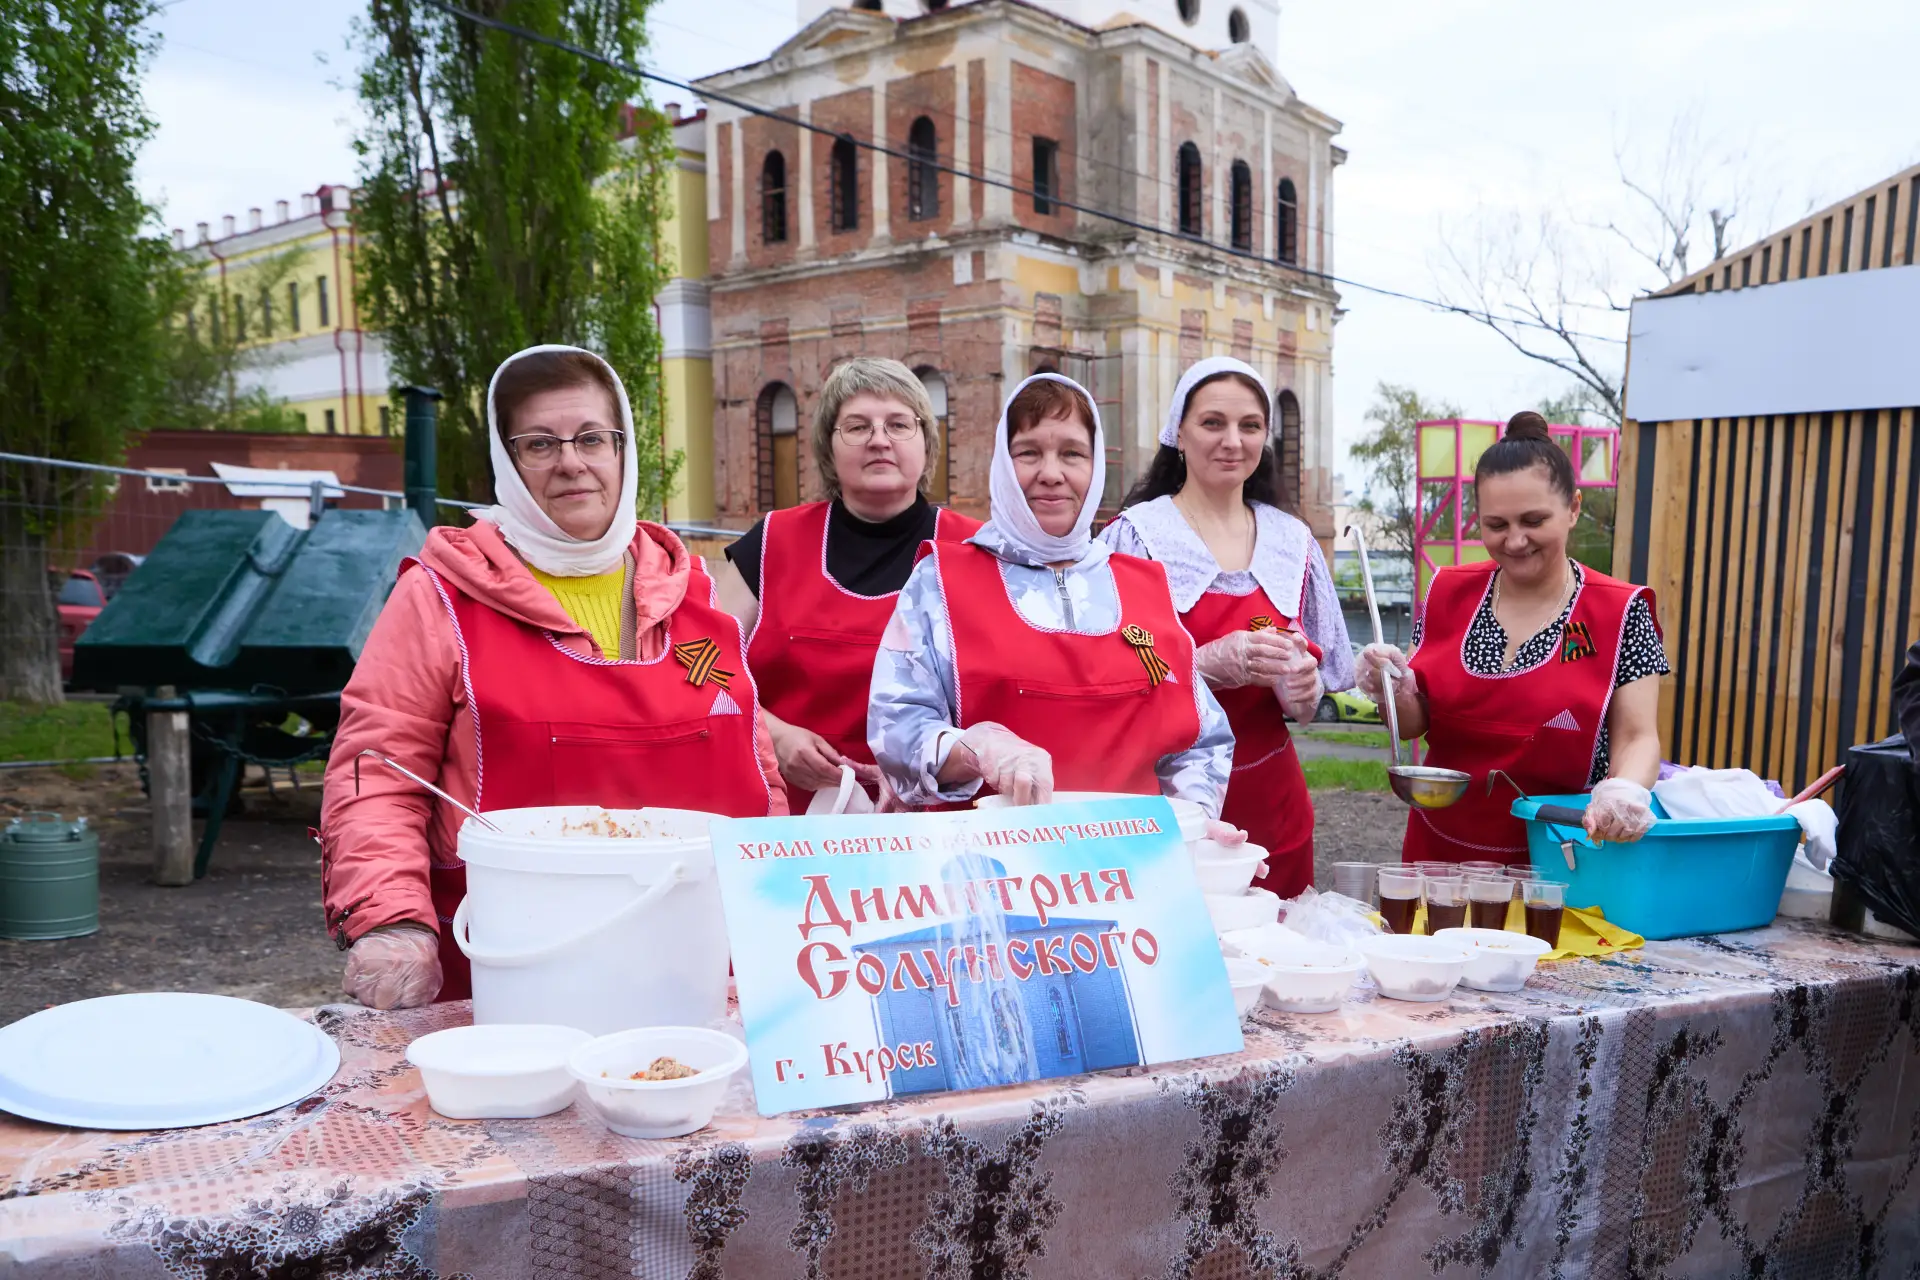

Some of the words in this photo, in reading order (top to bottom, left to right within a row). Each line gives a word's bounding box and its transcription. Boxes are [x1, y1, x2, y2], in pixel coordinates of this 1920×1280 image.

[737, 839, 815, 860] ХРАМ
[942, 818, 1162, 849] ЕЛИКОМУЧЕНИКА
[775, 1058, 805, 1083] г.
[820, 1040, 937, 1084] Курск
